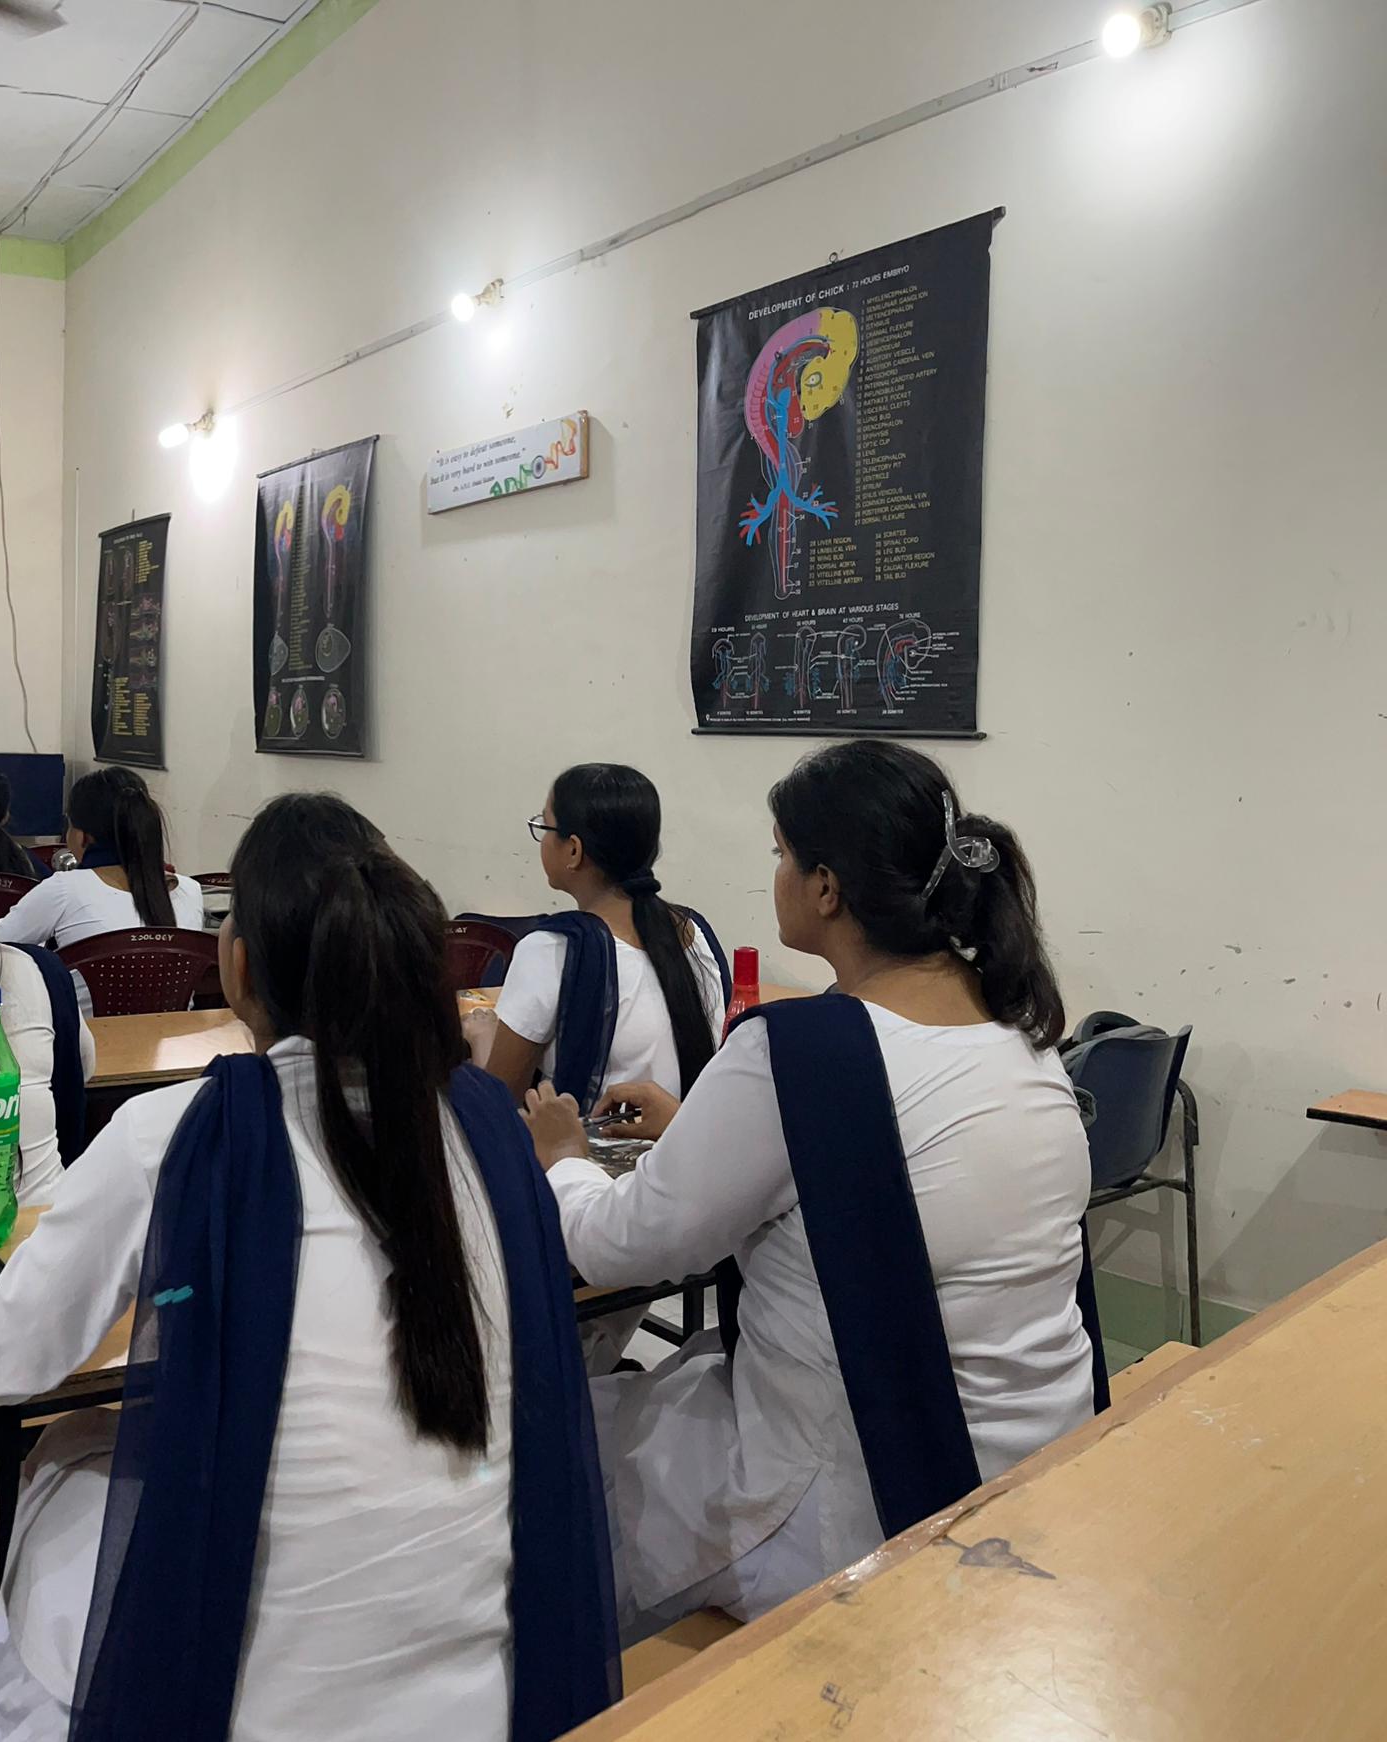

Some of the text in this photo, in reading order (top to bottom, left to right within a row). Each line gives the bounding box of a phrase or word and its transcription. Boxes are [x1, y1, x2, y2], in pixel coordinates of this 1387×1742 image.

[748, 297, 803, 320] DEVELOPMENT
[805, 292, 816, 304] OF
[818, 284, 845, 300] CHICK
[852, 281, 859, 289] 72
[860, 273, 882, 287] HOURS
[882, 264, 910, 280] EMBRYO
[791, 609, 810, 617] HEART
[817, 607, 837, 616] BRAIN
[838, 606, 847, 614] AT
[848, 604, 874, 613] VARIOUS
[875, 602, 900, 612] STAGES
